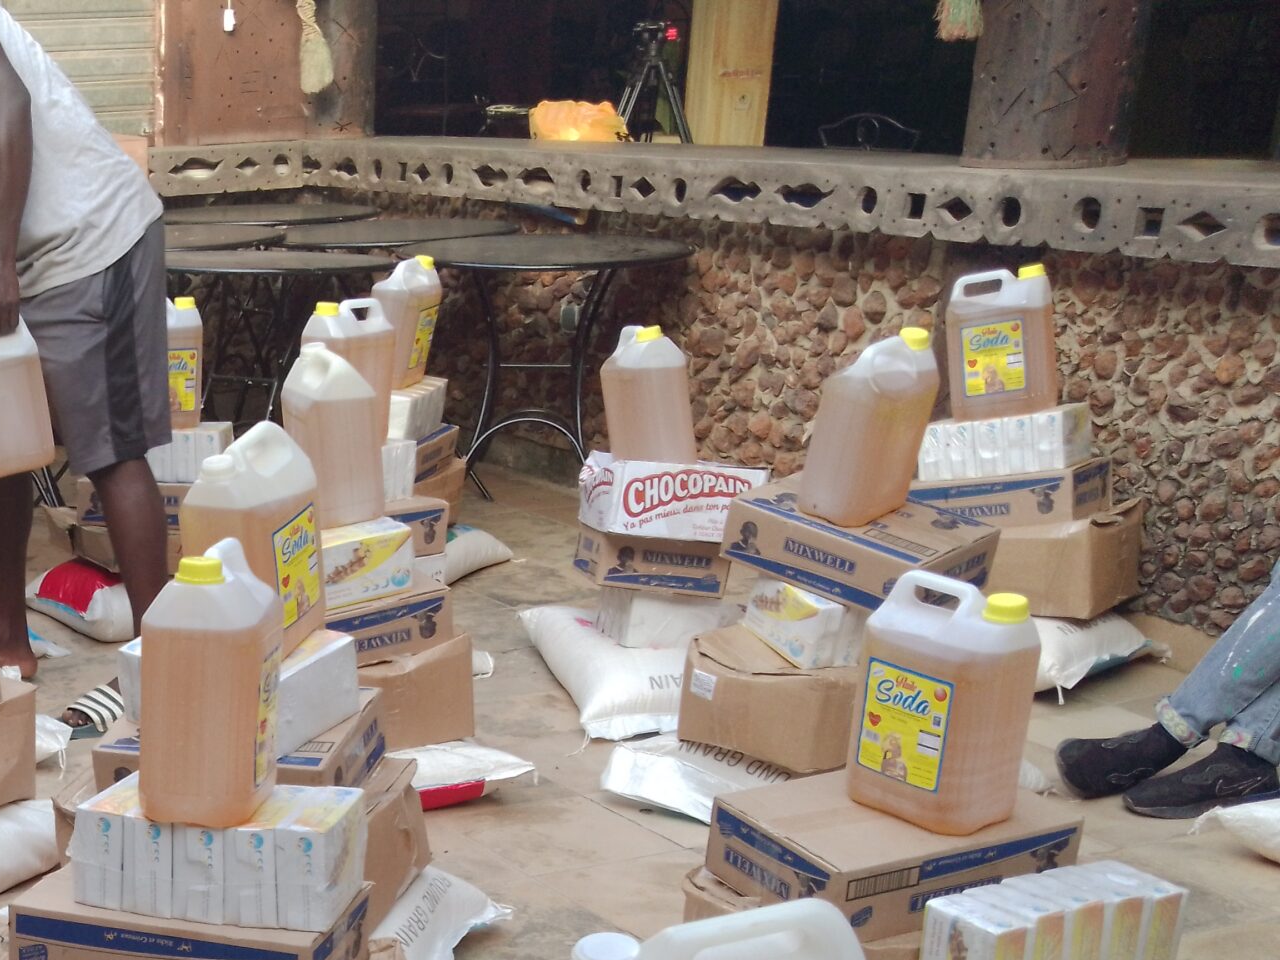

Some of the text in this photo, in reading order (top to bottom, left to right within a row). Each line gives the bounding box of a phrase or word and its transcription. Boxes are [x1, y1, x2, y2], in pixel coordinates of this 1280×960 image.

[627, 472, 749, 513] CHOCOPAIN
[282, 527, 309, 563] Soda
[787, 539, 855, 573] MIXWELL
[876, 679, 931, 716] Soda
